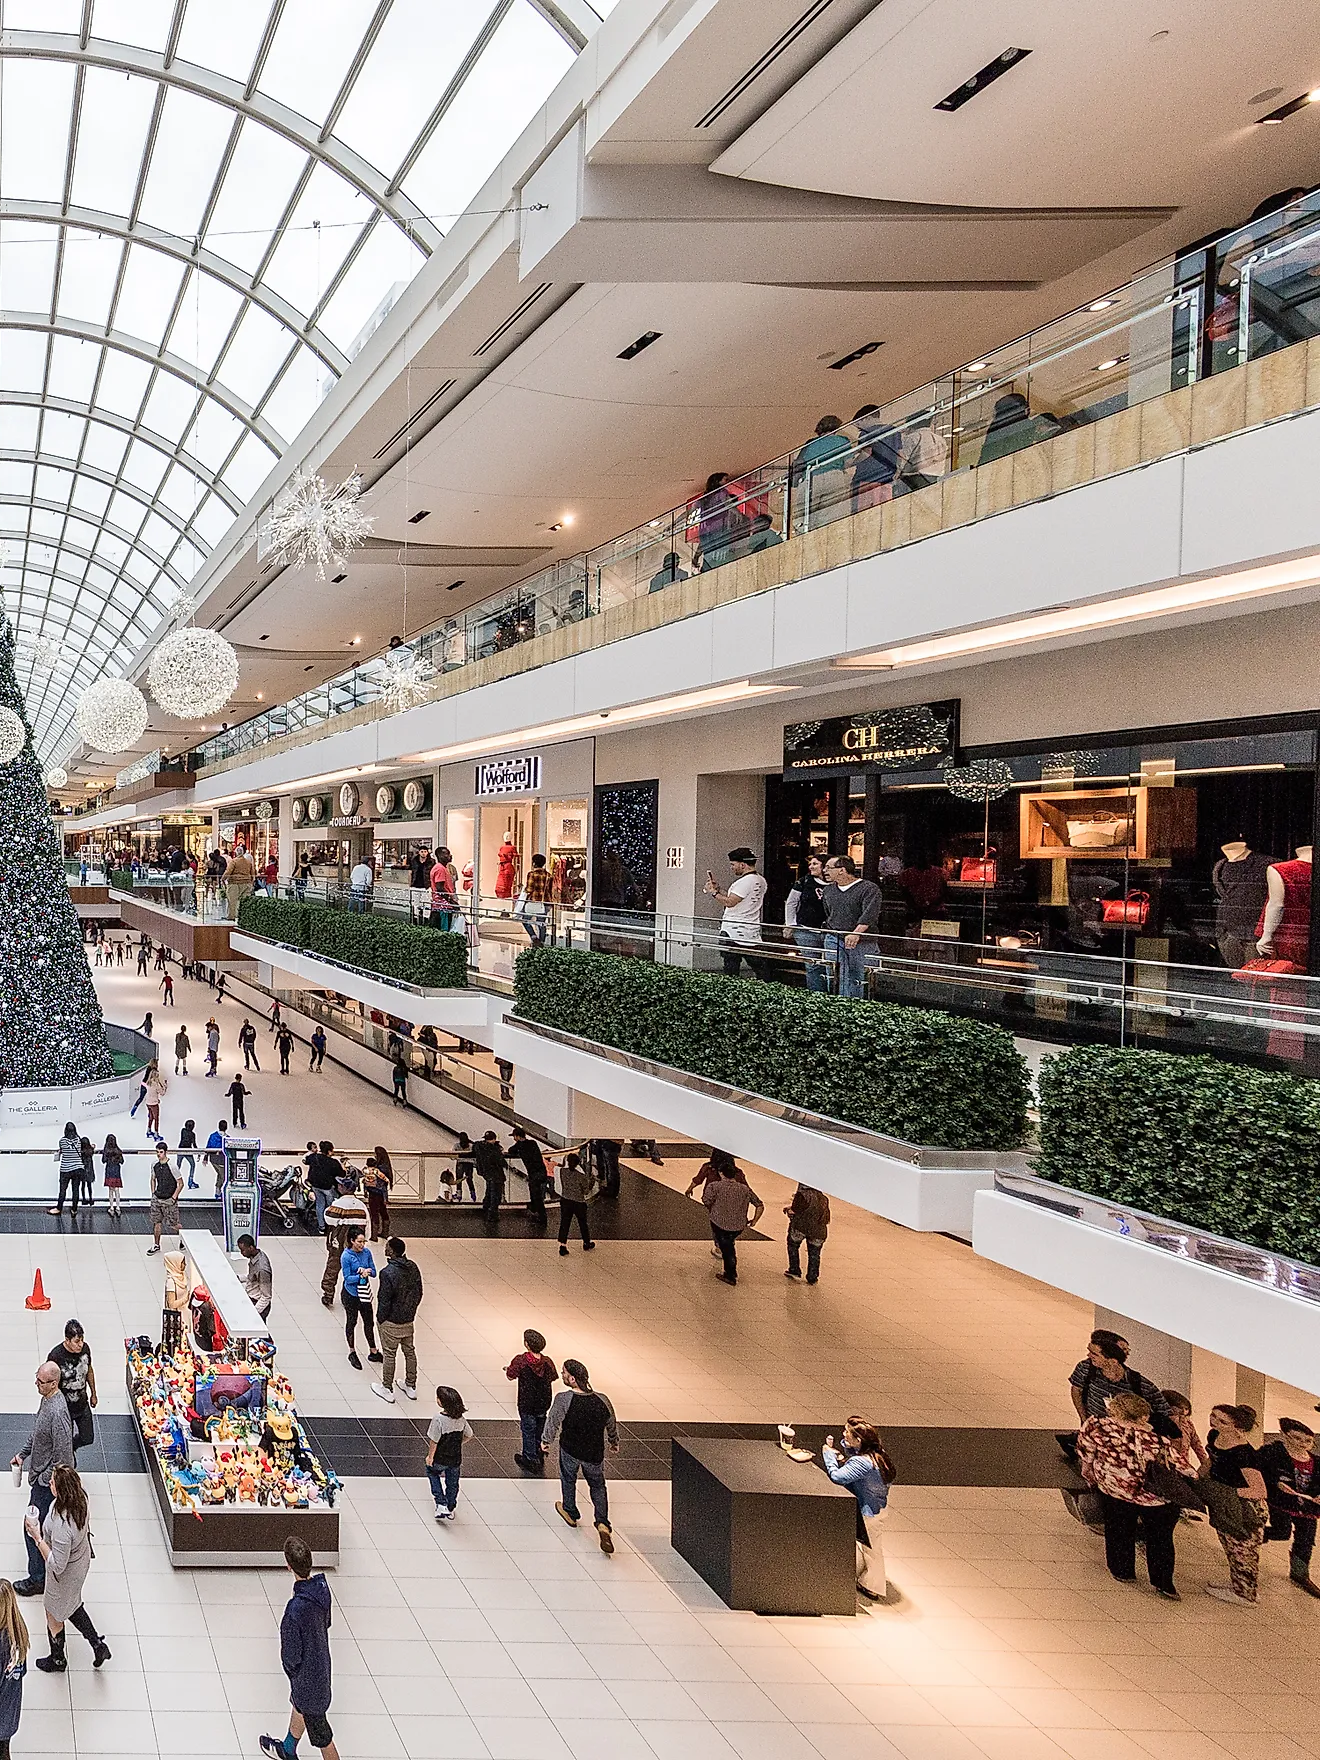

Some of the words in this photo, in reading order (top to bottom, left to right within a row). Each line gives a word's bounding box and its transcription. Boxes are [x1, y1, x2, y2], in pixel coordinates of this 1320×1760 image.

[842, 726, 879, 750] CH
[791, 754, 861, 769] CAROLINA
[861, 745, 943, 761] HERRERA
[485, 766, 526, 787] Wolford
[23, 1105, 58, 1113] GALLERIA
[92, 1095, 120, 1105] GALLERIA
